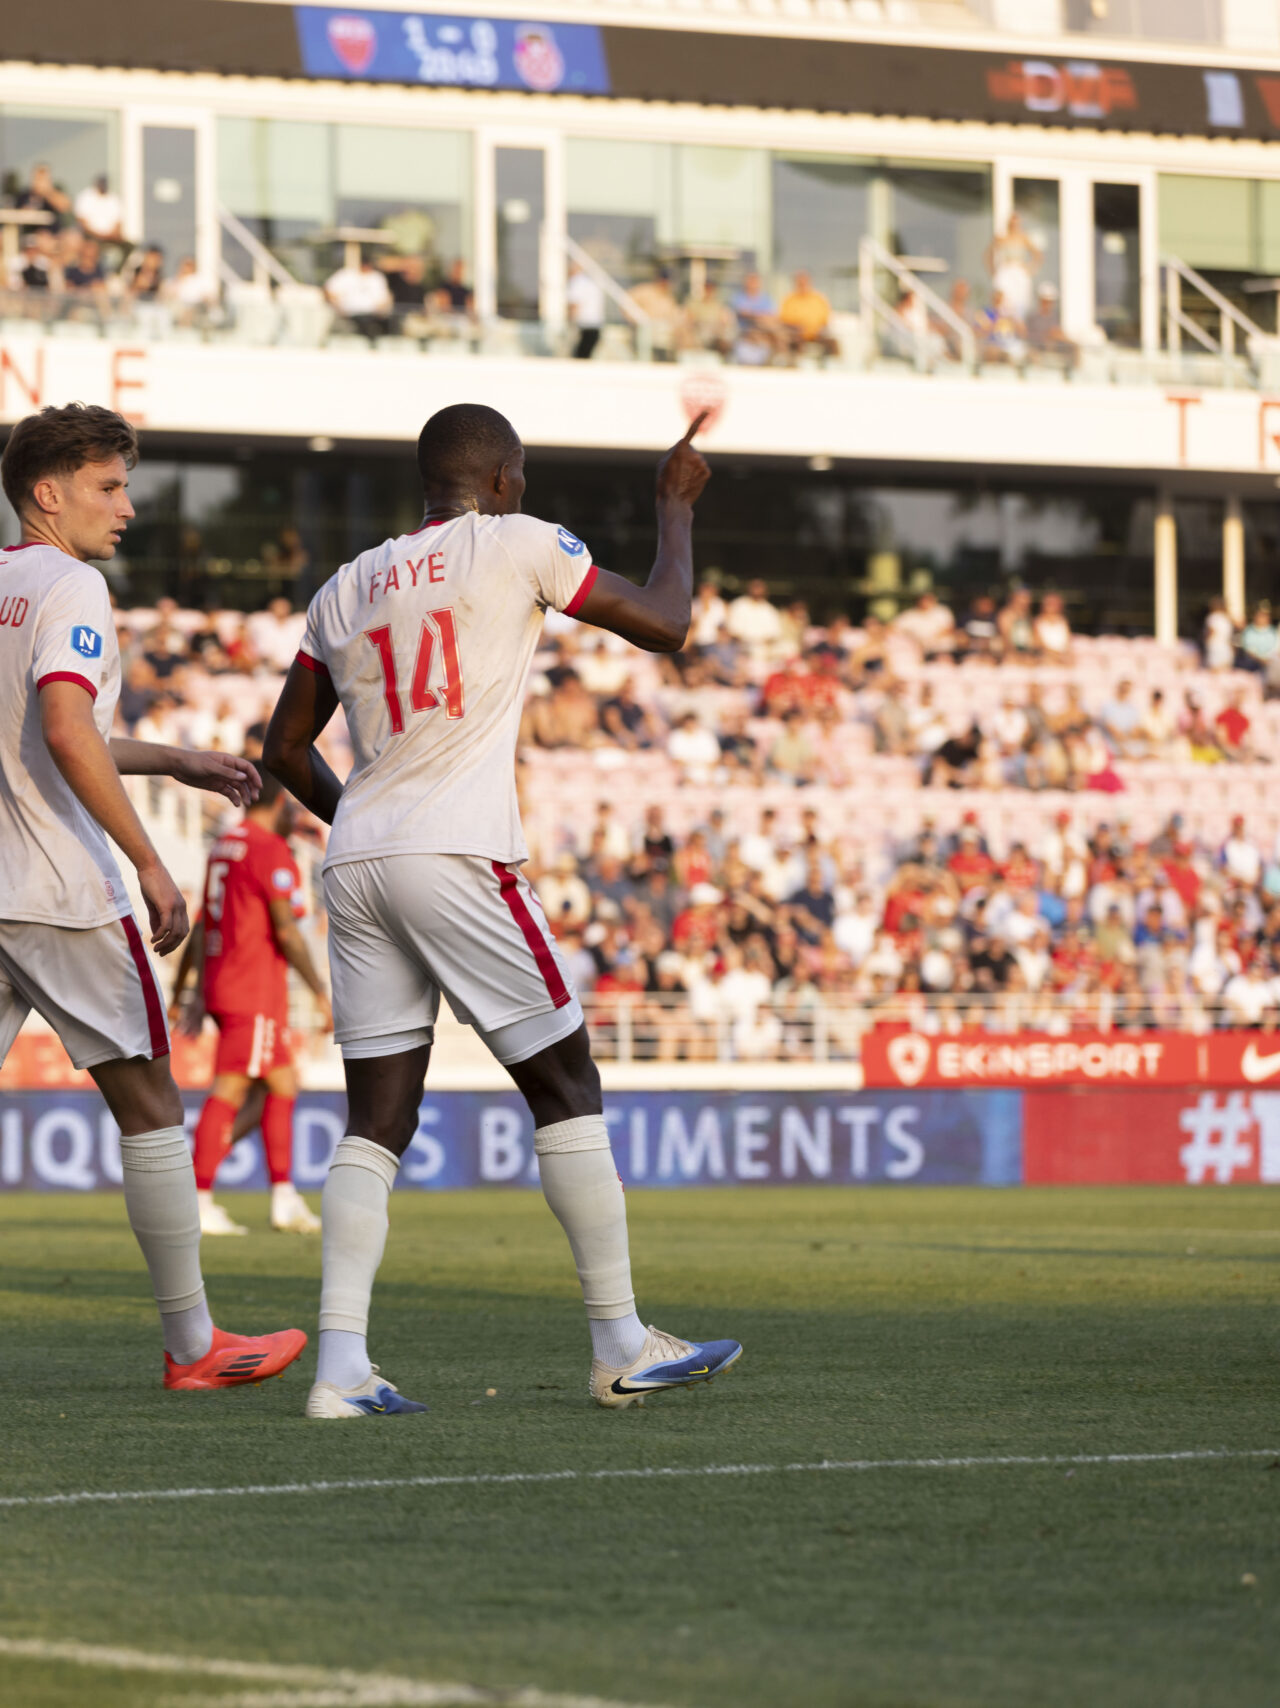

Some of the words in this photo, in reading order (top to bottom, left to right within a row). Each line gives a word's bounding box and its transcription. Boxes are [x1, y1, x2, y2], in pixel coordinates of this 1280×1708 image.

[369, 551, 446, 604] FAYE
[363, 606, 465, 737] 14
[936, 1042, 1164, 1079] EKINSPORT
[478, 1104, 926, 1182] BIMENTS
